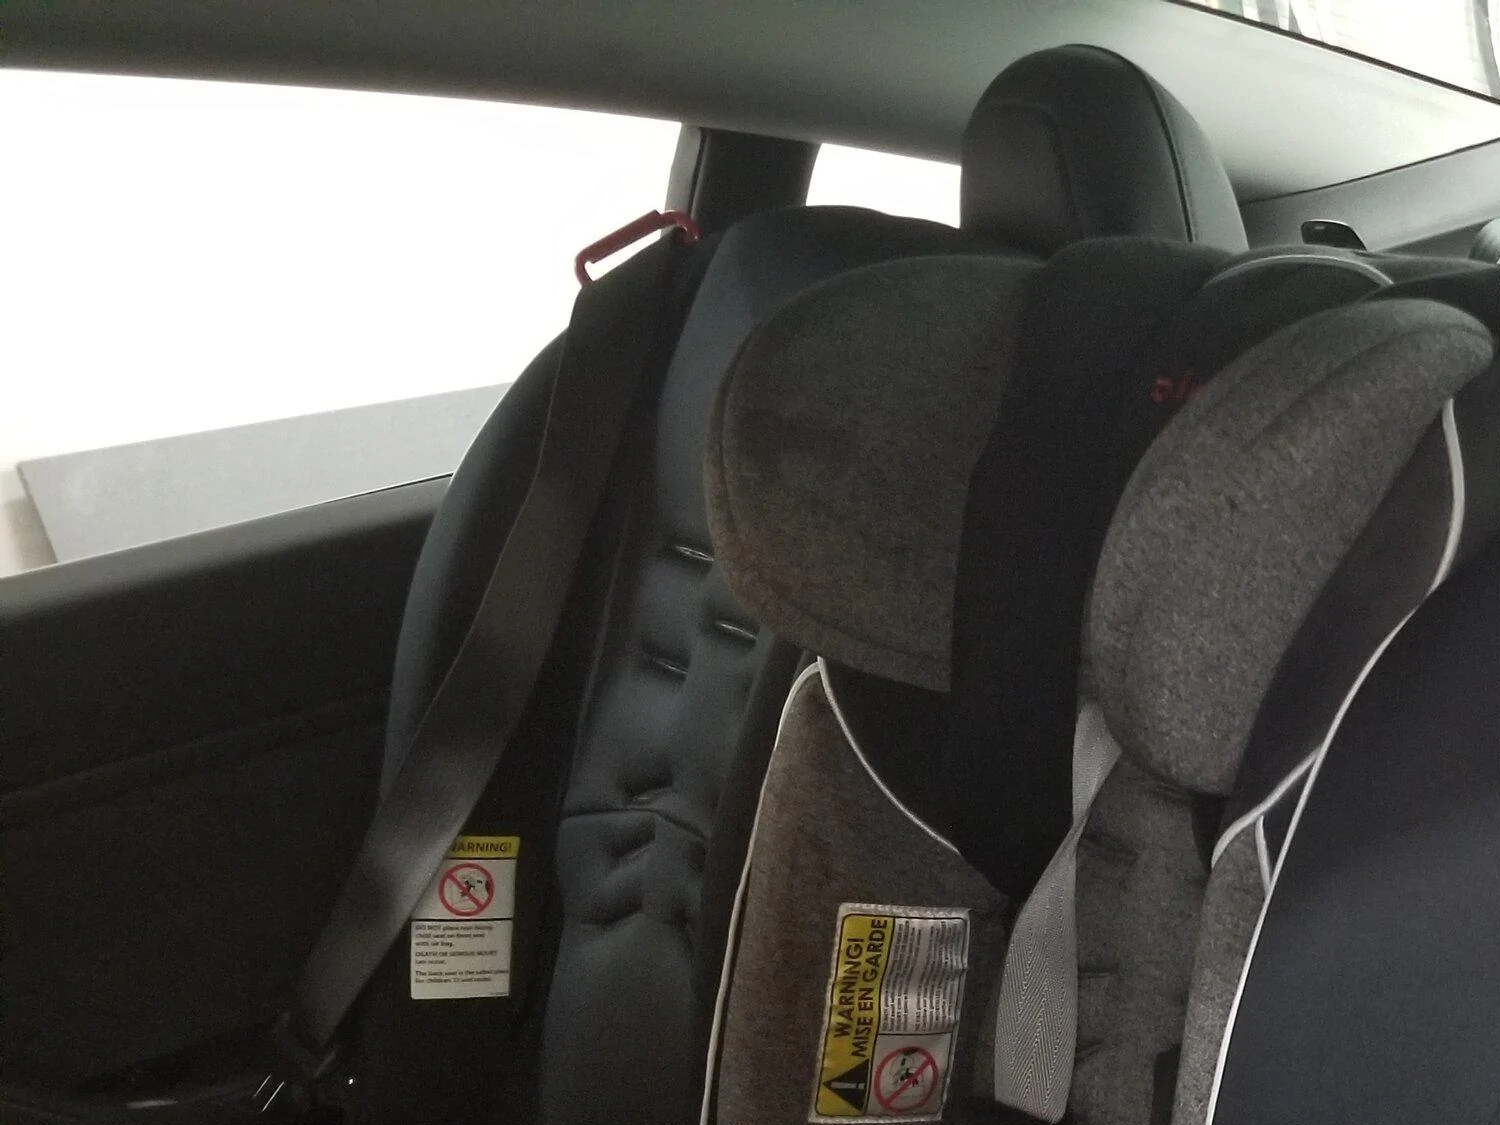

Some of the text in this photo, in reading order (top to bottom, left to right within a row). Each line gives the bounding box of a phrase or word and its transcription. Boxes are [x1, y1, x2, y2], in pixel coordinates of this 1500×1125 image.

[833, 938, 866, 1039] WARNING!
[851, 918, 888, 1058] MISE EN GARDE
